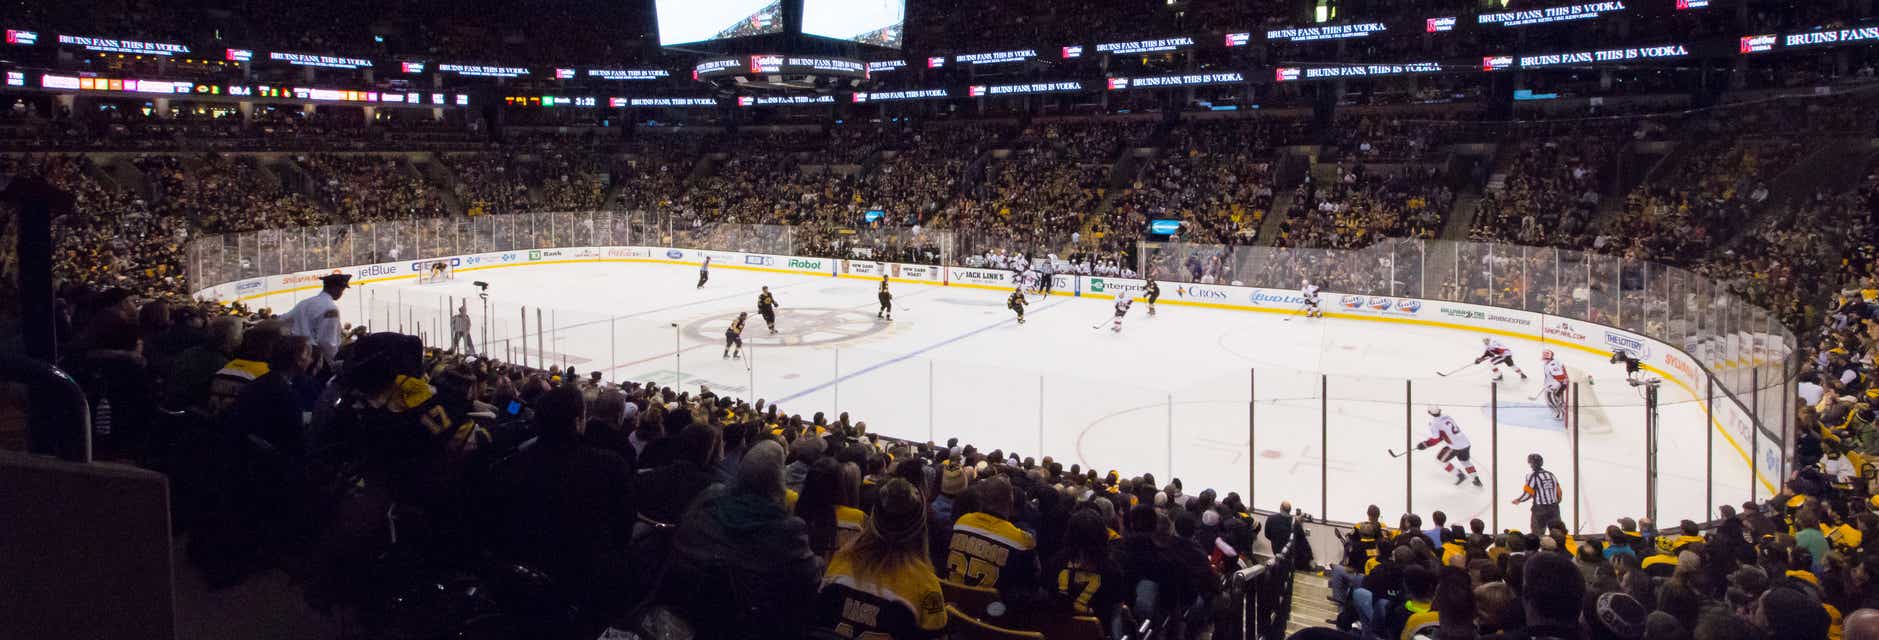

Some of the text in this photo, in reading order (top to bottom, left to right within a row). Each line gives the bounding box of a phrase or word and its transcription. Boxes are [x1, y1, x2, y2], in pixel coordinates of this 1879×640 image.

[1479, 13, 1514, 23] BRUINS
[1545, 7, 1569, 18] THIS
[1572, 5, 1580, 15] IS
[1786, 32, 1837, 46] BRUINS
[1521, 55, 1559, 66] BRUINS
[1596, 50, 1622, 61] THIS
[1626, 49, 1637, 59] IS
[788, 259, 821, 269] iRobot
[358, 265, 397, 279] jetBlue
[1618, 337, 1641, 350] LOTTERY
